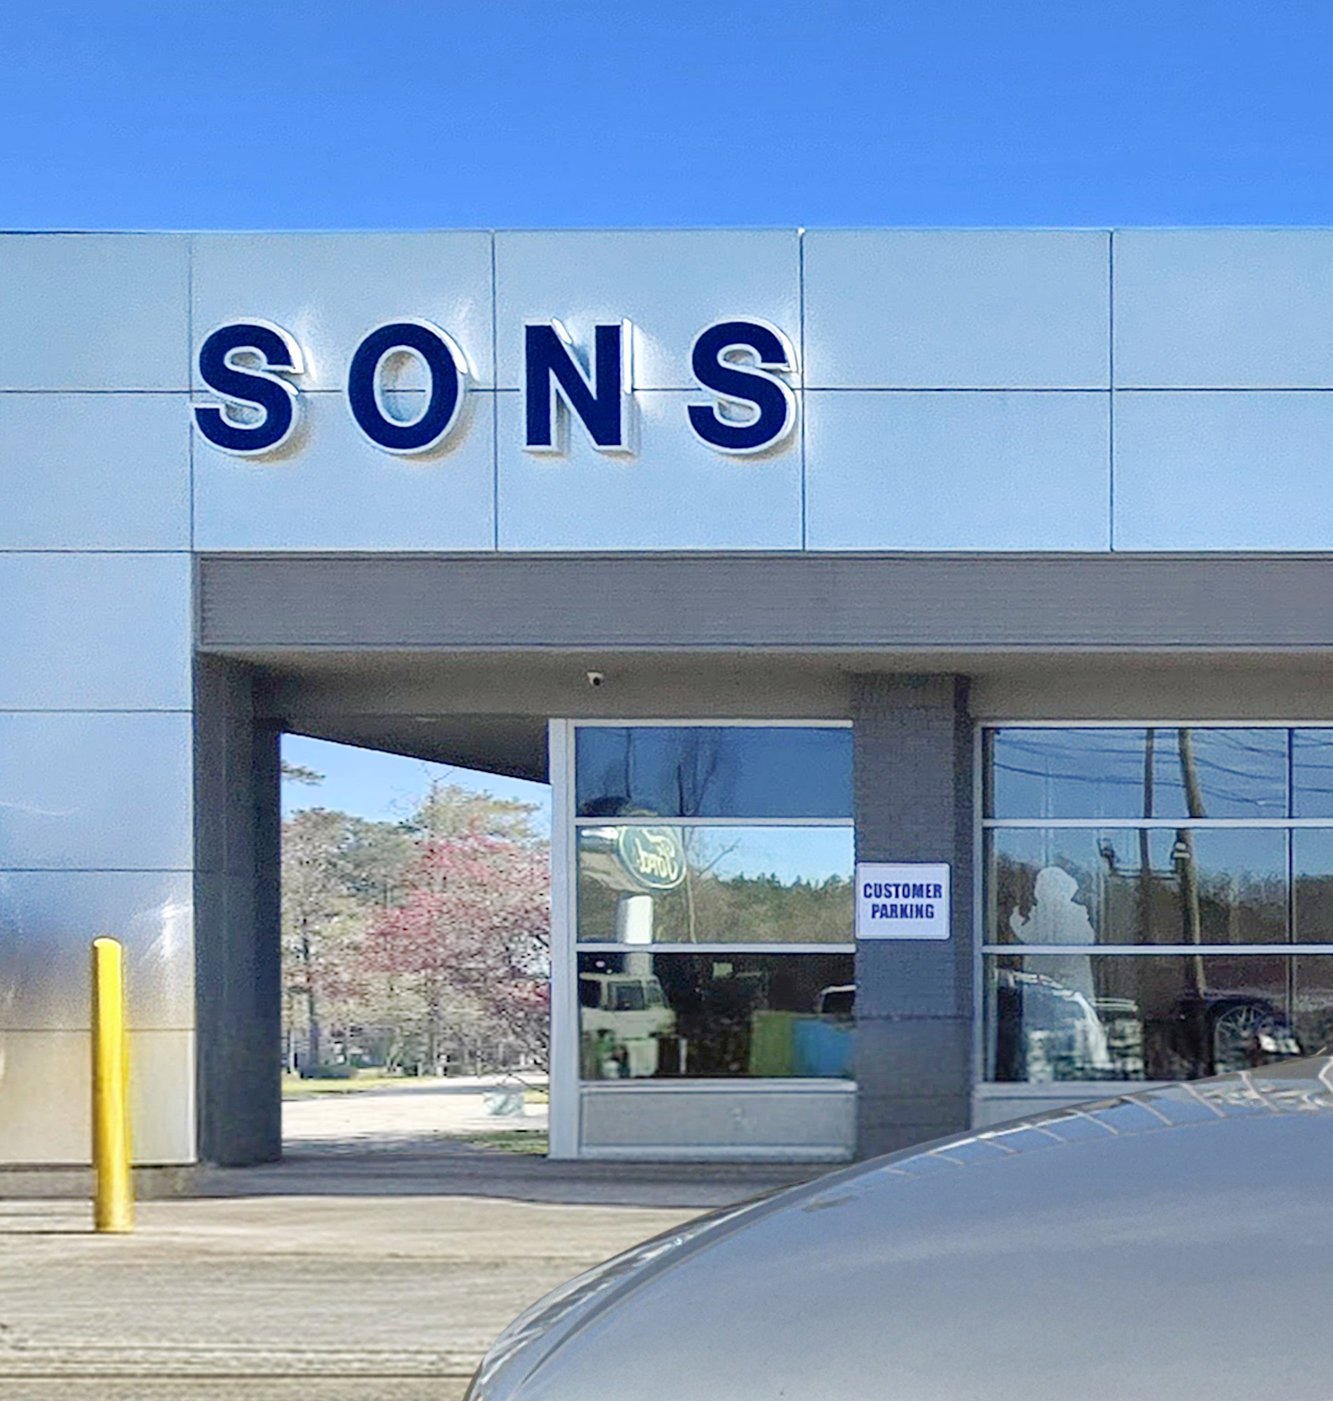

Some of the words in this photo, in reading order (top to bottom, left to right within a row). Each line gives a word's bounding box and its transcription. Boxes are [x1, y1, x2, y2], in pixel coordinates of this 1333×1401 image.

[194, 320, 790, 452] SONS
[863, 883, 942, 899] CUSTOMER
[871, 904, 935, 919] PARKING
